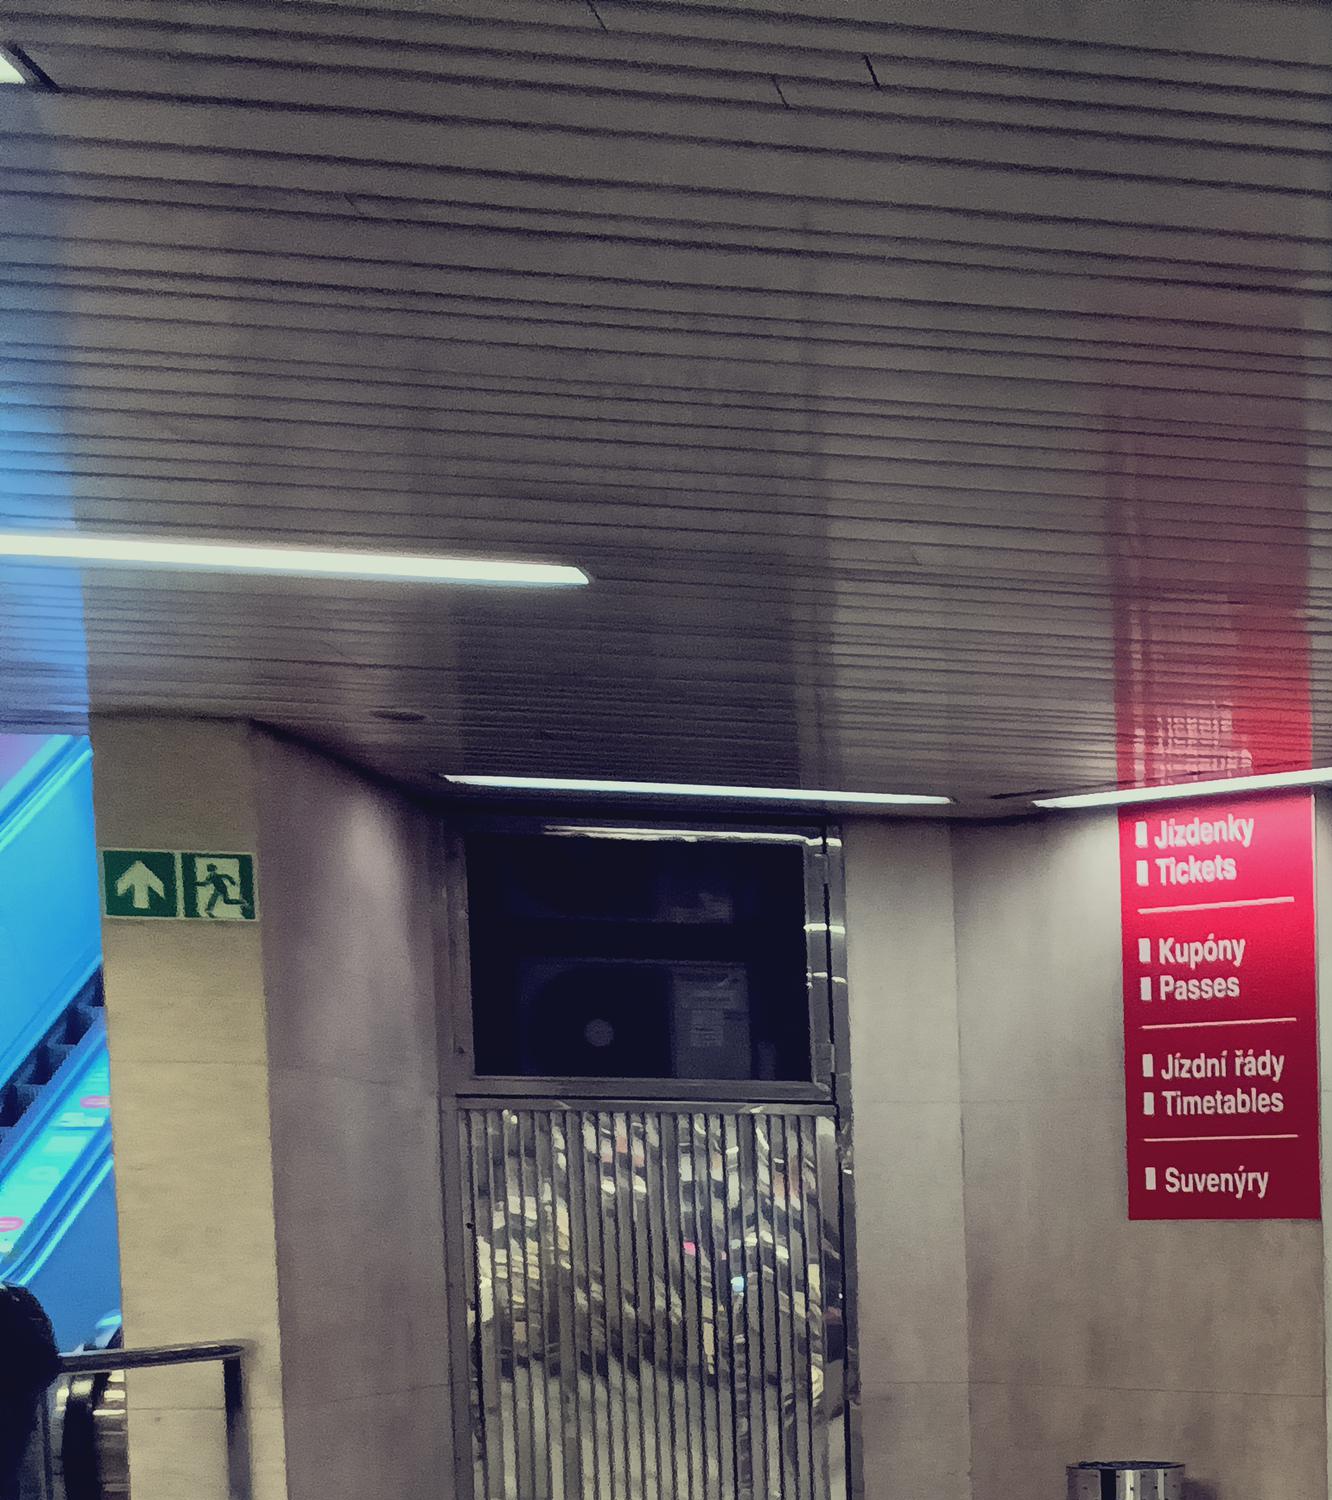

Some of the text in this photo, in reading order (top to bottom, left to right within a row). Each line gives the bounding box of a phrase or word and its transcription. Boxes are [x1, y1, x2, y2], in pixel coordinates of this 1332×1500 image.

[1153, 813, 1255, 849] Jízdenky
[1154, 854, 1238, 886] Tickets
[1158, 933, 1246, 970] Kupóny
[1159, 974, 1241, 1001] Passes
[1160, 1049, 1285, 1082] Jízdní řády
[1161, 1086, 1285, 1117] Timetables
[1164, 1166, 1270, 1199] Suvenýry
